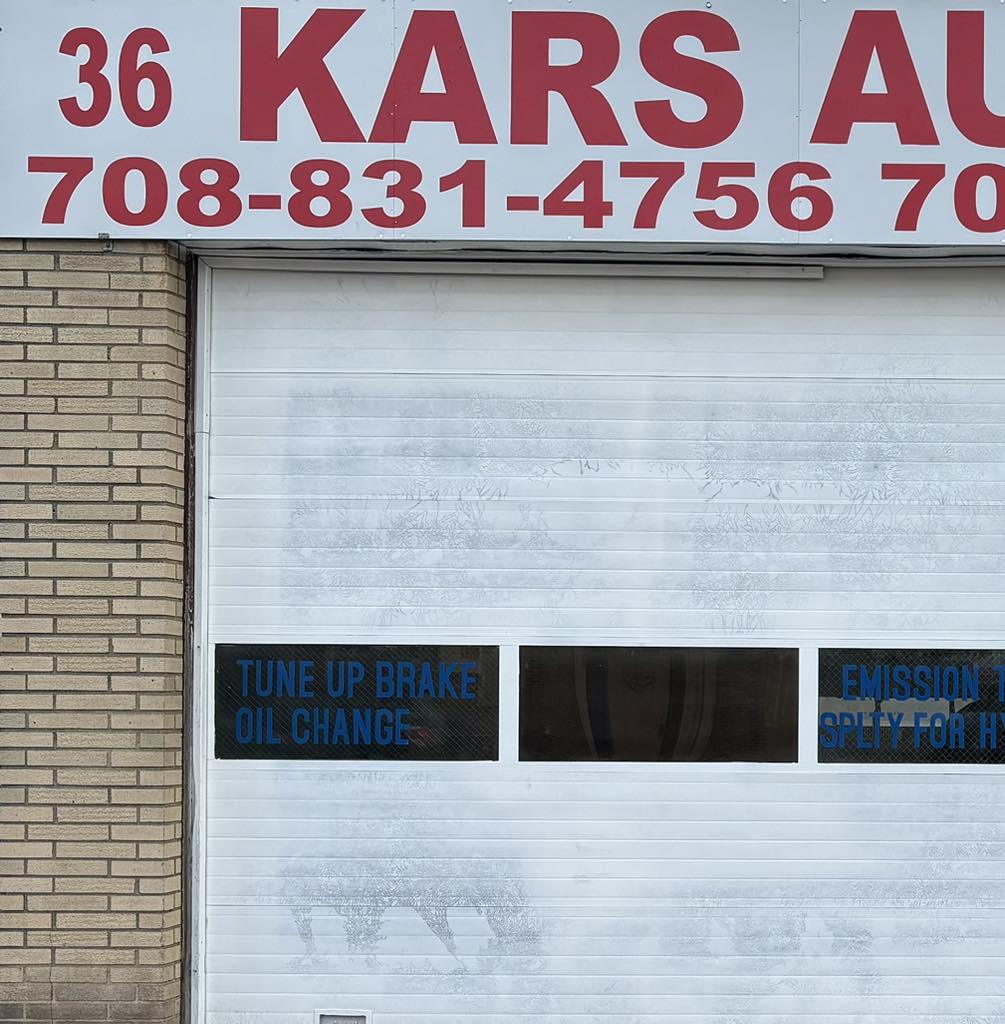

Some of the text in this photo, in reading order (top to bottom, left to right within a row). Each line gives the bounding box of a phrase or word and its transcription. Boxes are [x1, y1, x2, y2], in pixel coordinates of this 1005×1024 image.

[58, 27, 172, 128] 36
[240, 7, 744, 149] KARS
[27, 156, 833, 232] 708-831-4756
[237, 659, 478, 700] TUNE UP BRAKE
[840, 664, 981, 702] EMISSION
[234, 706, 410, 746] OIL CHANGE
[818, 711, 905, 749] SPLTY
[914, 712, 966, 749] FOR
